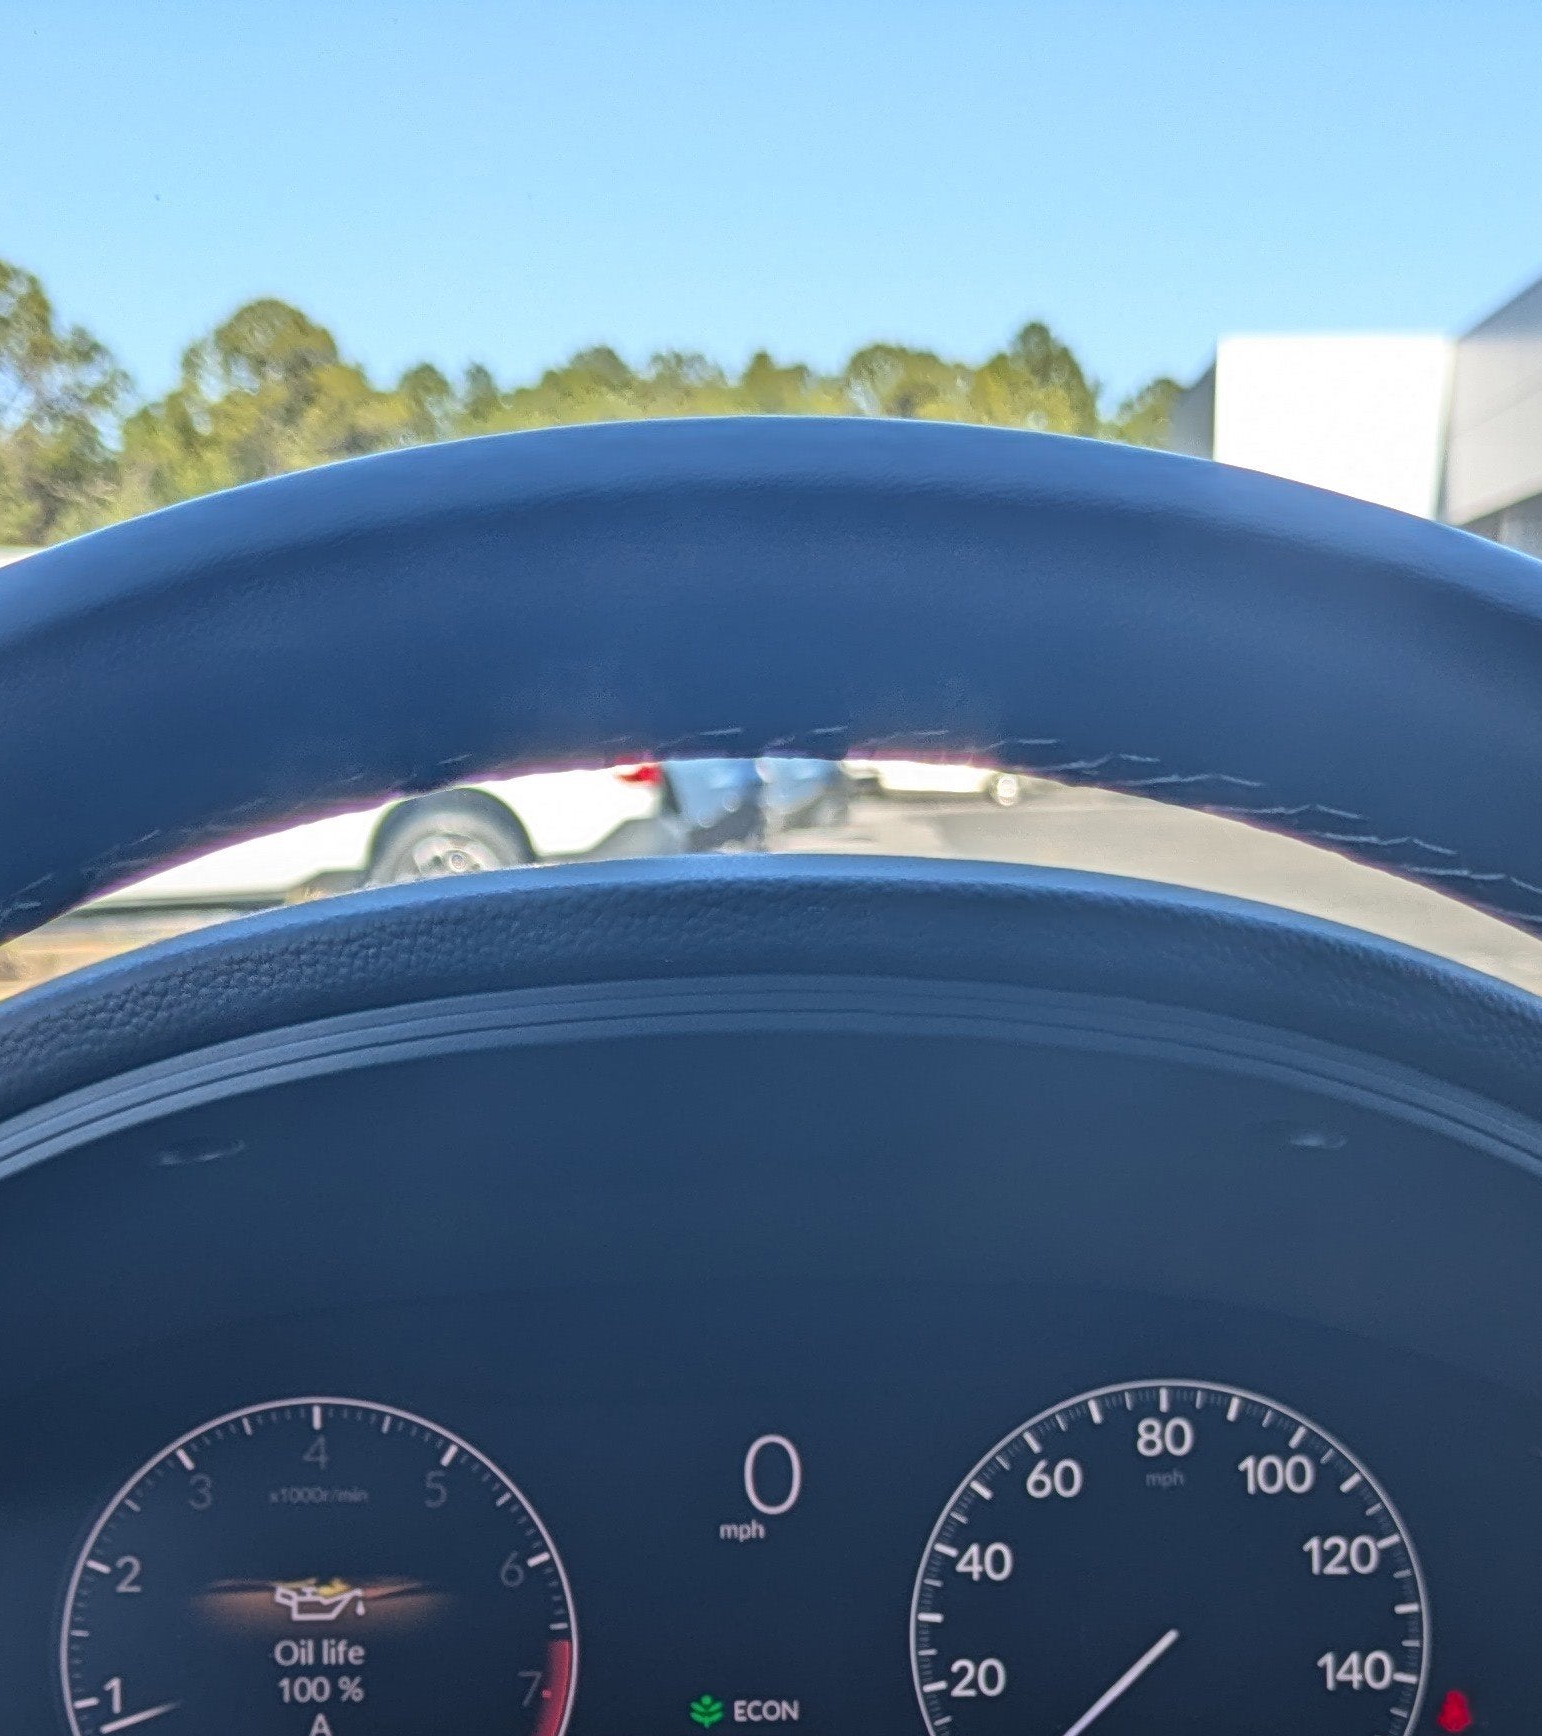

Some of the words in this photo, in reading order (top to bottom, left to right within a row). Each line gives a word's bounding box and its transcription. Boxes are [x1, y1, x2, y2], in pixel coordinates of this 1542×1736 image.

[303, 1436, 330, 1470] 4
[1137, 1418, 1193, 1458] 80
[424, 1472, 448, 1507] 5
[744, 1433, 802, 1515] 0
[1026, 1459, 1084, 1500] 60
[1239, 1454, 1315, 1496] 100
[189, 1475, 213, 1509] 3
[719, 1520, 766, 1542] mph
[501, 1552, 525, 1588] 6
[955, 1542, 1013, 1581] 40
[1303, 1536, 1380, 1576] 120
[114, 1559, 142, 1594] 2
[273, 1639, 315, 1666] Oil
[322, 1639, 366, 1666] life
[518, 1671, 542, 1706] 7
[950, 1658, 1006, 1698] 20
[1317, 1651, 1394, 1691] 140
[102, 1677, 123, 1712] 1
[278, 1676, 331, 1703] 100
[734, 1700, 800, 1722] ECON
